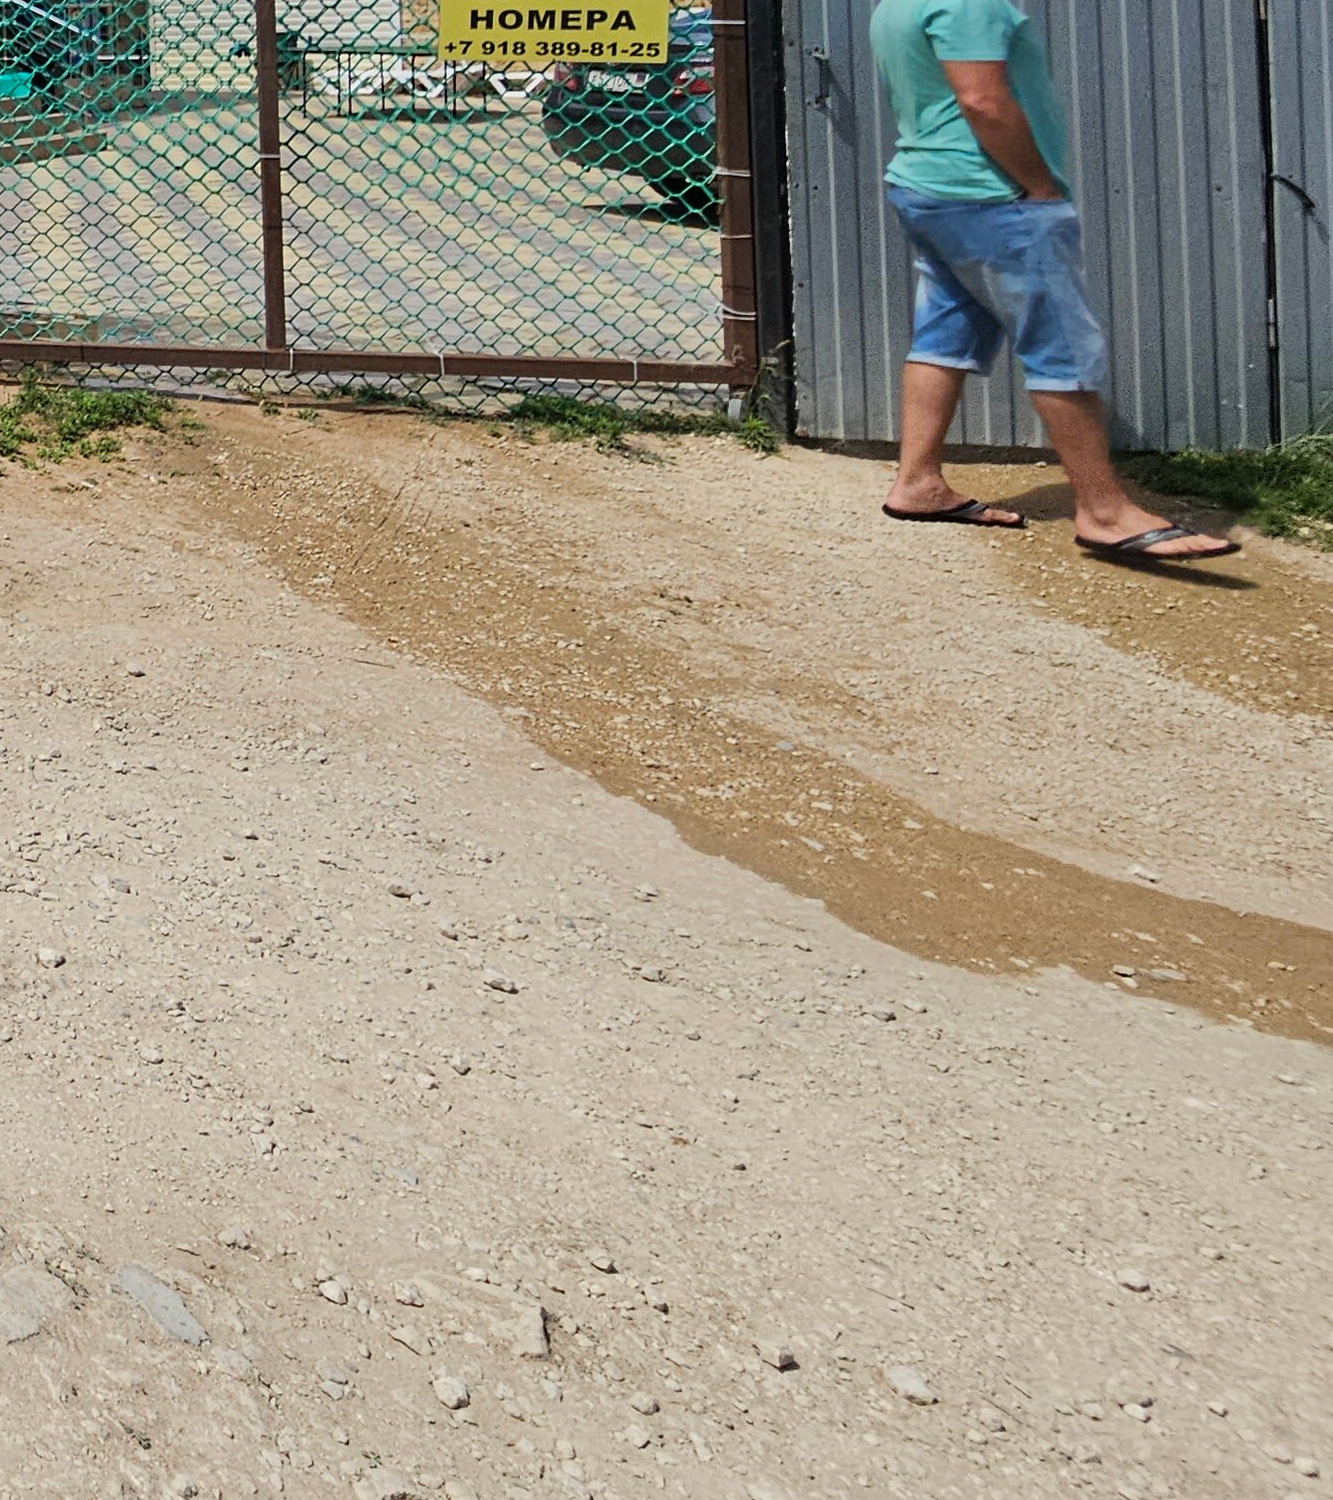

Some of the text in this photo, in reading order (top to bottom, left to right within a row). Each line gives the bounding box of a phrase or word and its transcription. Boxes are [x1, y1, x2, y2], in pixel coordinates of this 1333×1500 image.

[469, 9, 636, 31] НОМЕРА
[444, 40, 661, 57] +7 918 389-81-25
